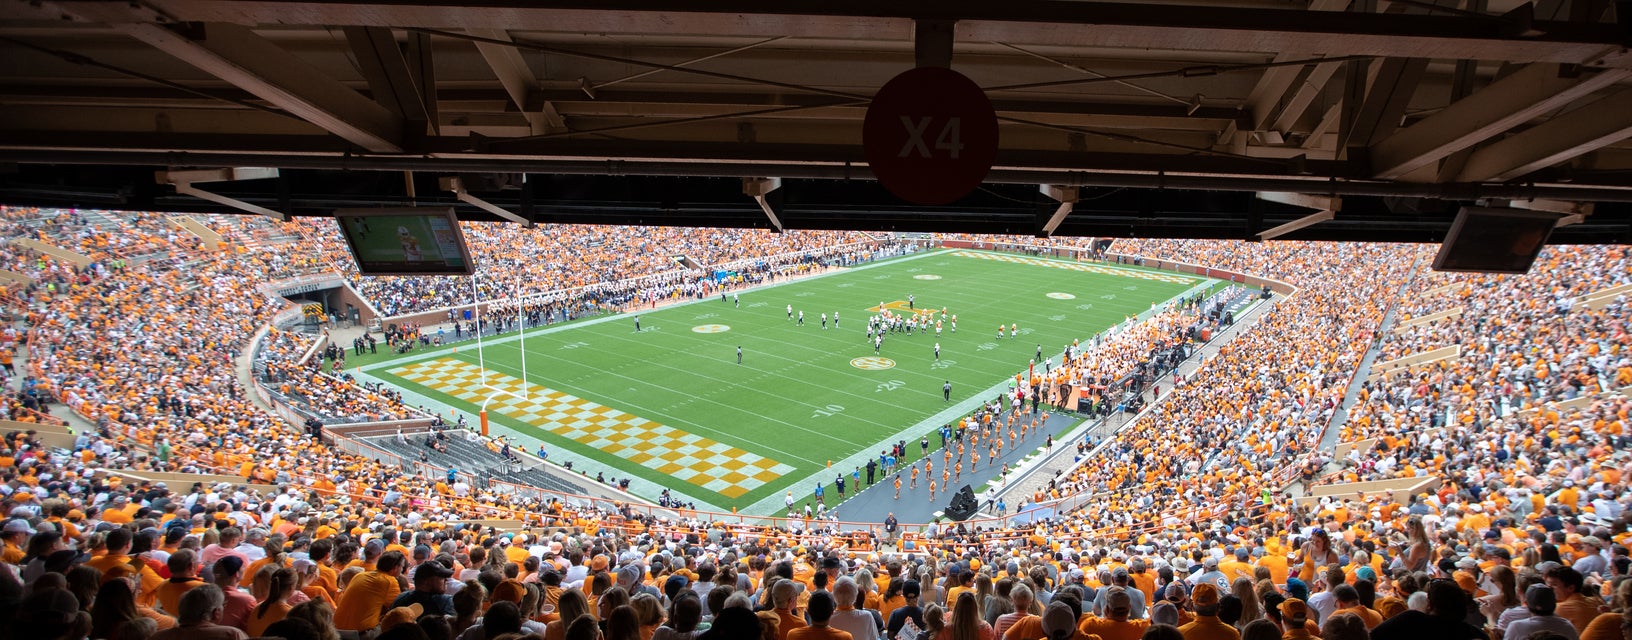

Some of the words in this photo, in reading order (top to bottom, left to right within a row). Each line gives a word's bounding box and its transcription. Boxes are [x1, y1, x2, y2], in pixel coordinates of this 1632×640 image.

[897, 115, 965, 159] X4
[877, 379, 906, 391] 20
[813, 404, 845, 417] 10
